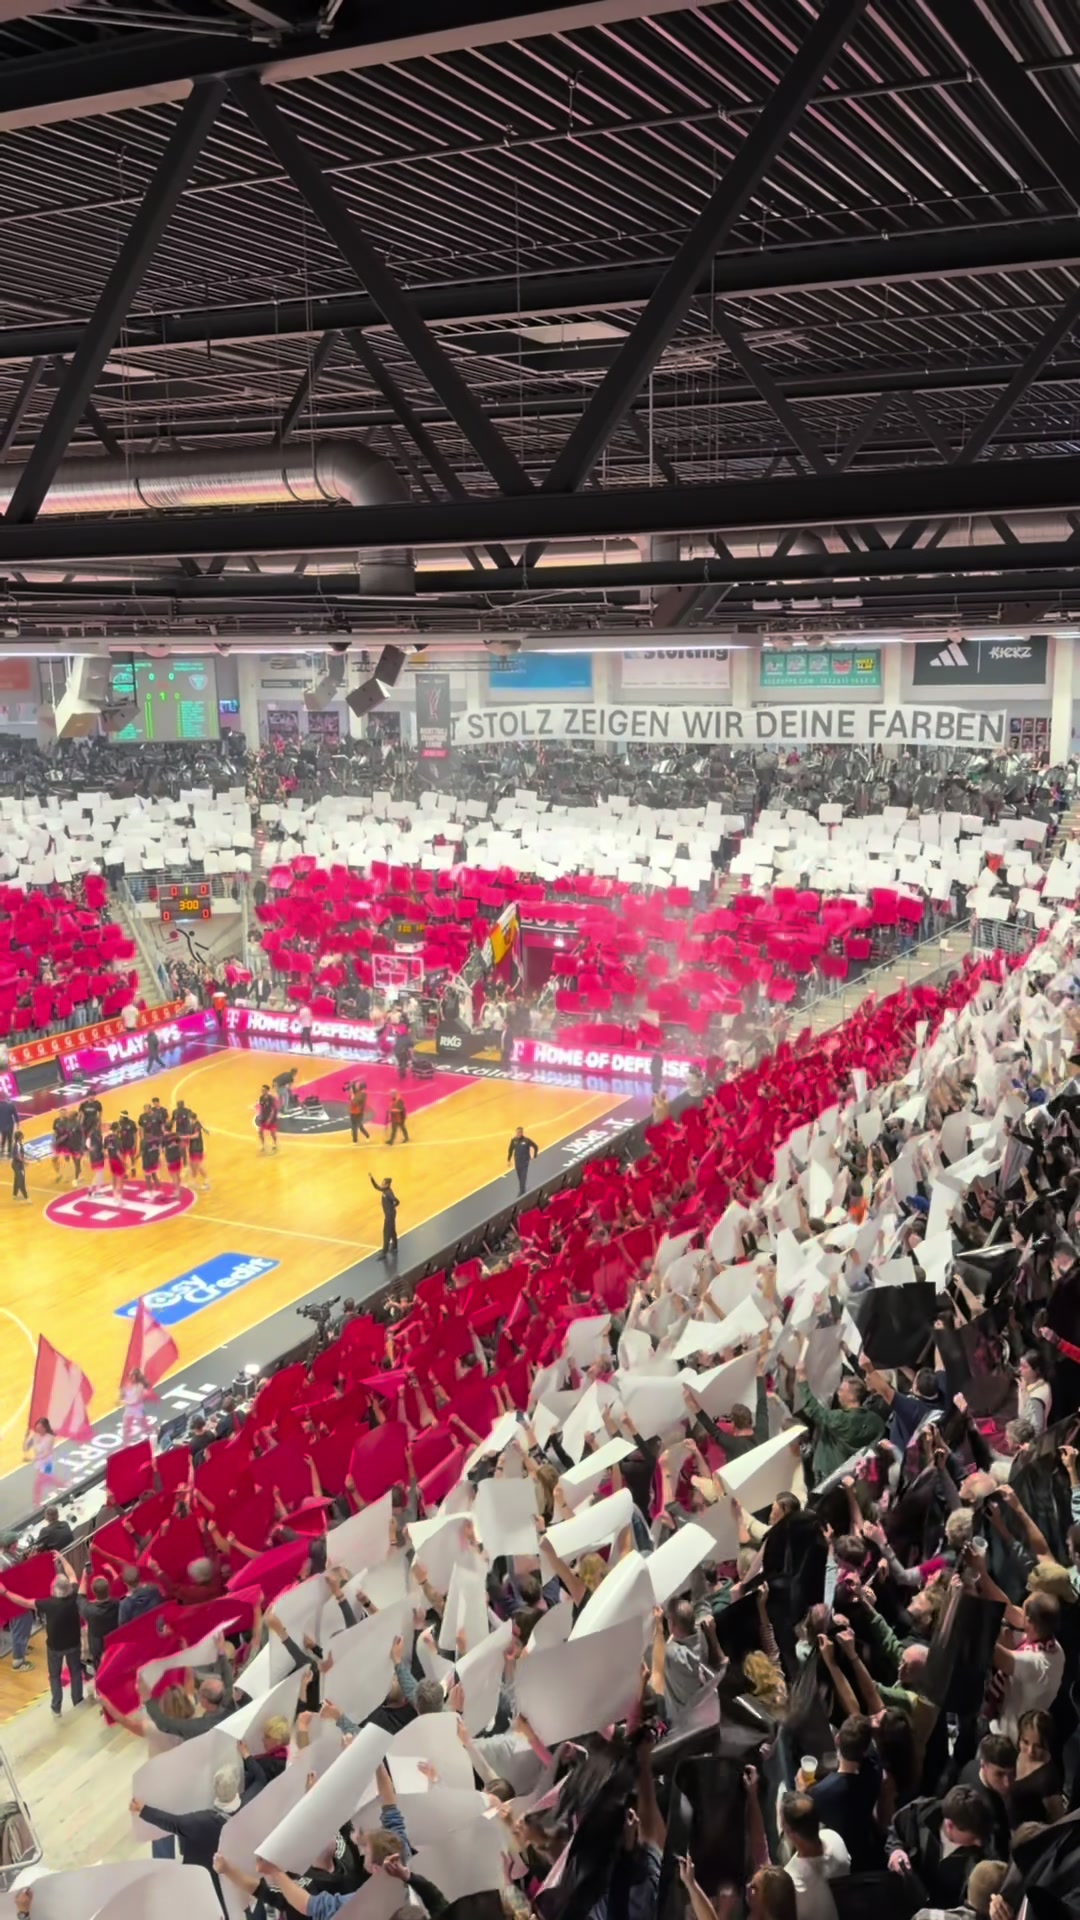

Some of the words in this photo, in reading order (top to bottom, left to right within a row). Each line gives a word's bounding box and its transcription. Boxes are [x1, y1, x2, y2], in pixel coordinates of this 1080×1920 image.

[468, 708, 554, 739] STOLZ
[563, 708, 670, 738] ZEIGEN
[682, 711, 744, 739] WIR
[756, 709, 855, 739] DEINE
[868, 709, 1004, 743] FARBEN
[247, 1009, 290, 1034] HOME
[311, 1020, 377, 1044] DEFENSE
[534, 1043, 583, 1068] HOME
[585, 1051, 609, 1070] OF
[183, 1257, 275, 1305] Credit
